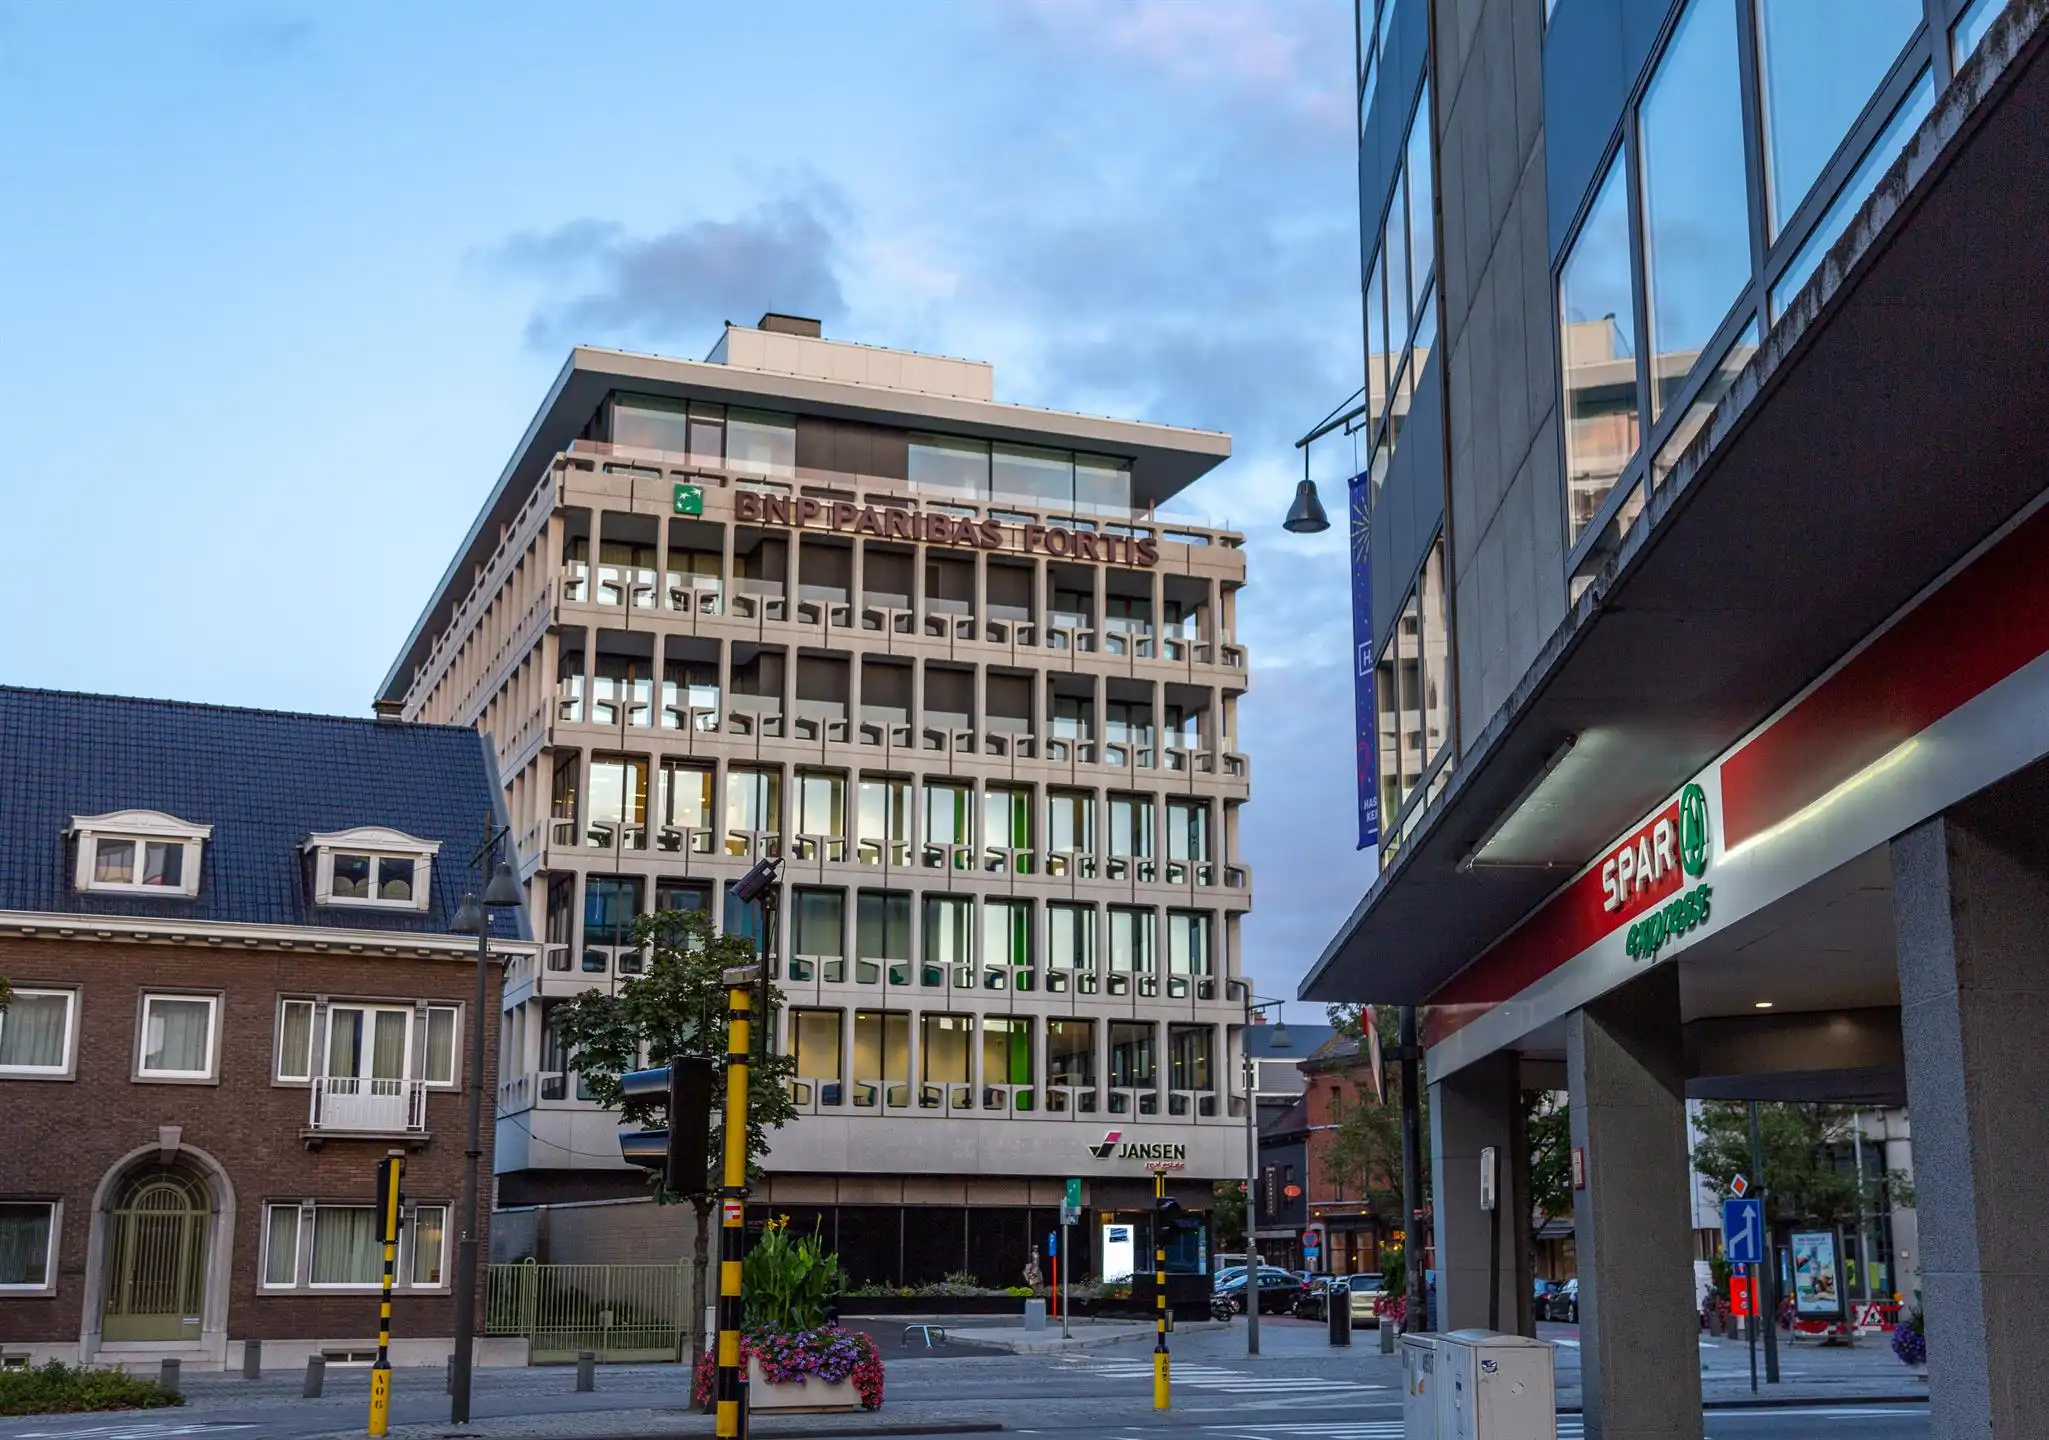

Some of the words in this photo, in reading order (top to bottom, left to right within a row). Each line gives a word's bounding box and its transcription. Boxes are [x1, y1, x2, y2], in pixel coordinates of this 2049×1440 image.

[735, 489, 821, 526] BNP
[834, 502, 1003, 548] PARIBAS
[1024, 524, 1160, 567] FORTIS
[1602, 818, 1676, 913] SPAR
[1626, 883, 1711, 959] express
[1118, 1143, 1186, 1160] JANSEN
